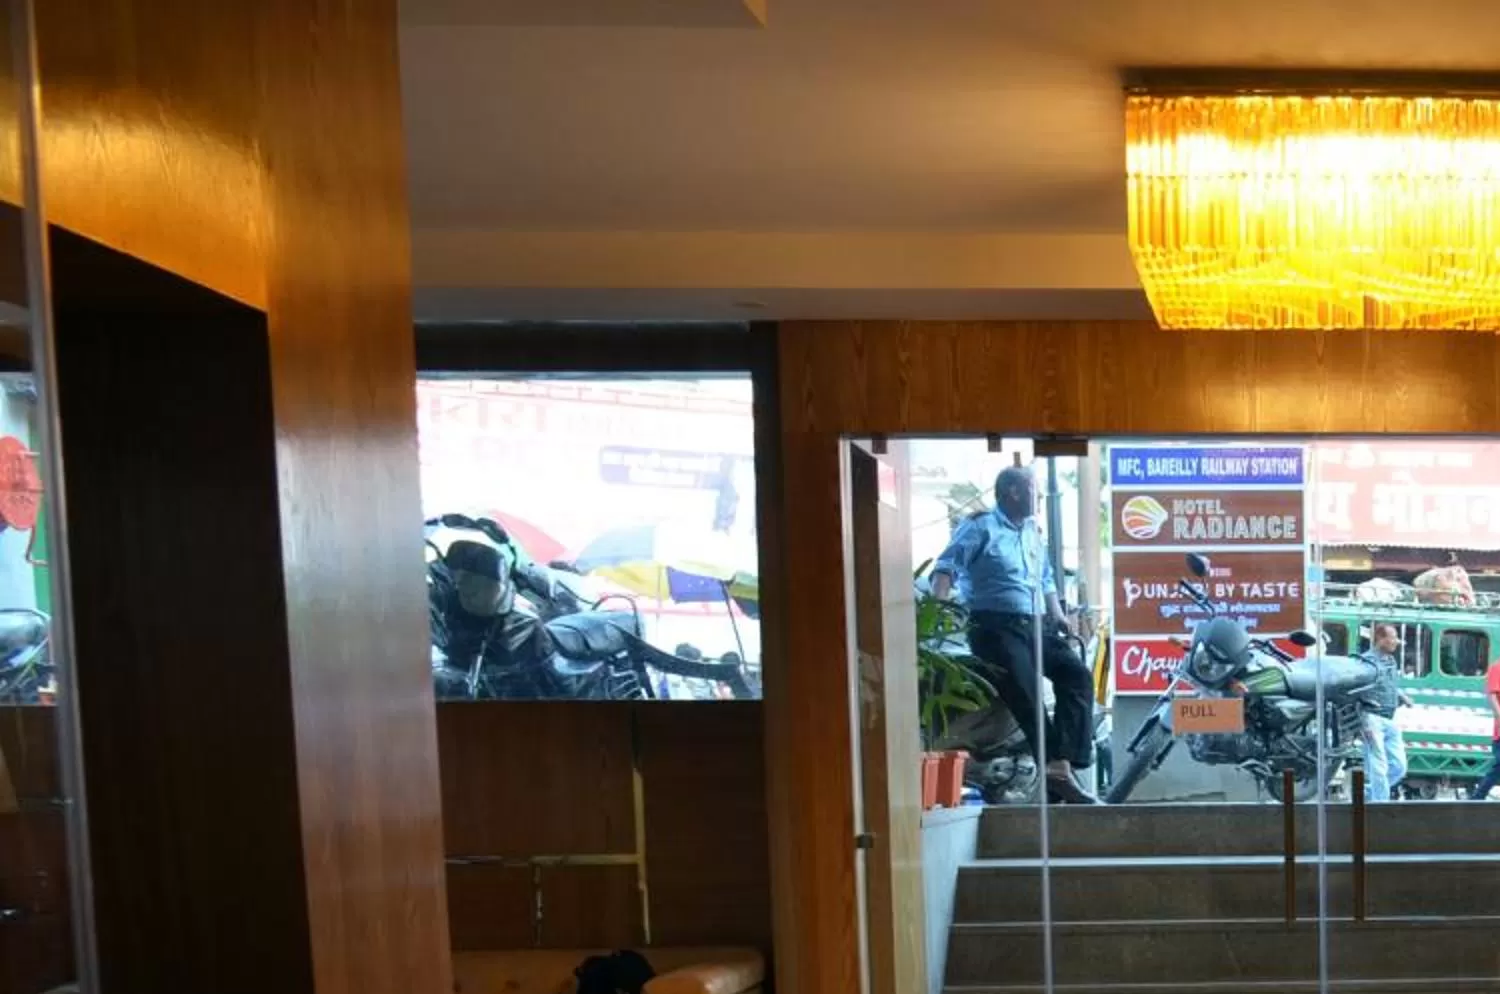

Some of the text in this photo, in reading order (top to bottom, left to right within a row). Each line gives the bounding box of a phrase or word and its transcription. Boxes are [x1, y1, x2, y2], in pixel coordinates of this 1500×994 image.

[1149, 457, 1199, 476] BAREILLY
[1201, 457, 1248, 476] RAILWAY
[1250, 457, 1298, 476] STATION
[1173, 499, 1225, 515] HOTEL
[1173, 516, 1297, 539] RADIANCE
[1215, 583, 1235, 597] BY
[1240, 582, 1299, 598] TASTE
[1181, 704, 1216, 718] PULL
